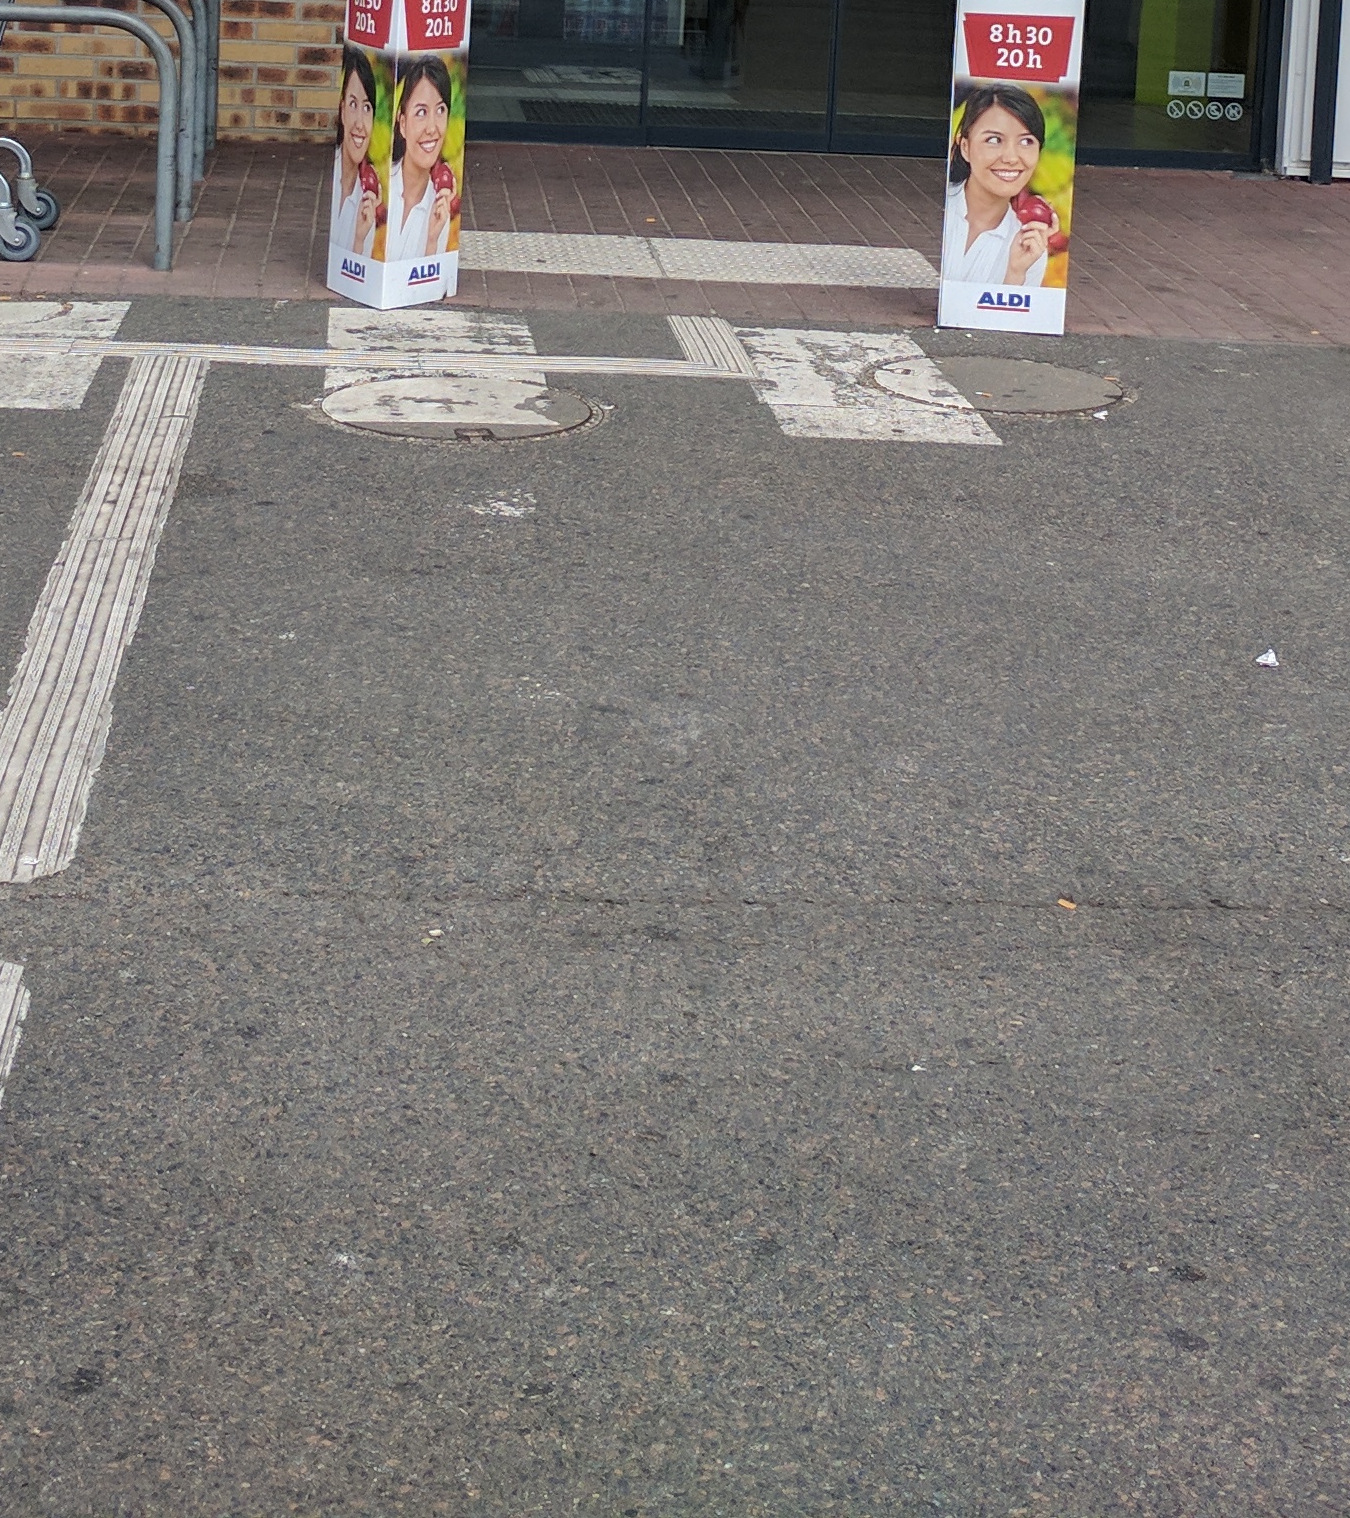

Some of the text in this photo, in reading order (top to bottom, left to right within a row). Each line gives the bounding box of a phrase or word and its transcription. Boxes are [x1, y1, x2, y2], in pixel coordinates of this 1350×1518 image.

[341, 258, 365, 278] ALDI
[408, 262, 440, 281] ALDI
[977, 291, 1031, 308] ALDI
